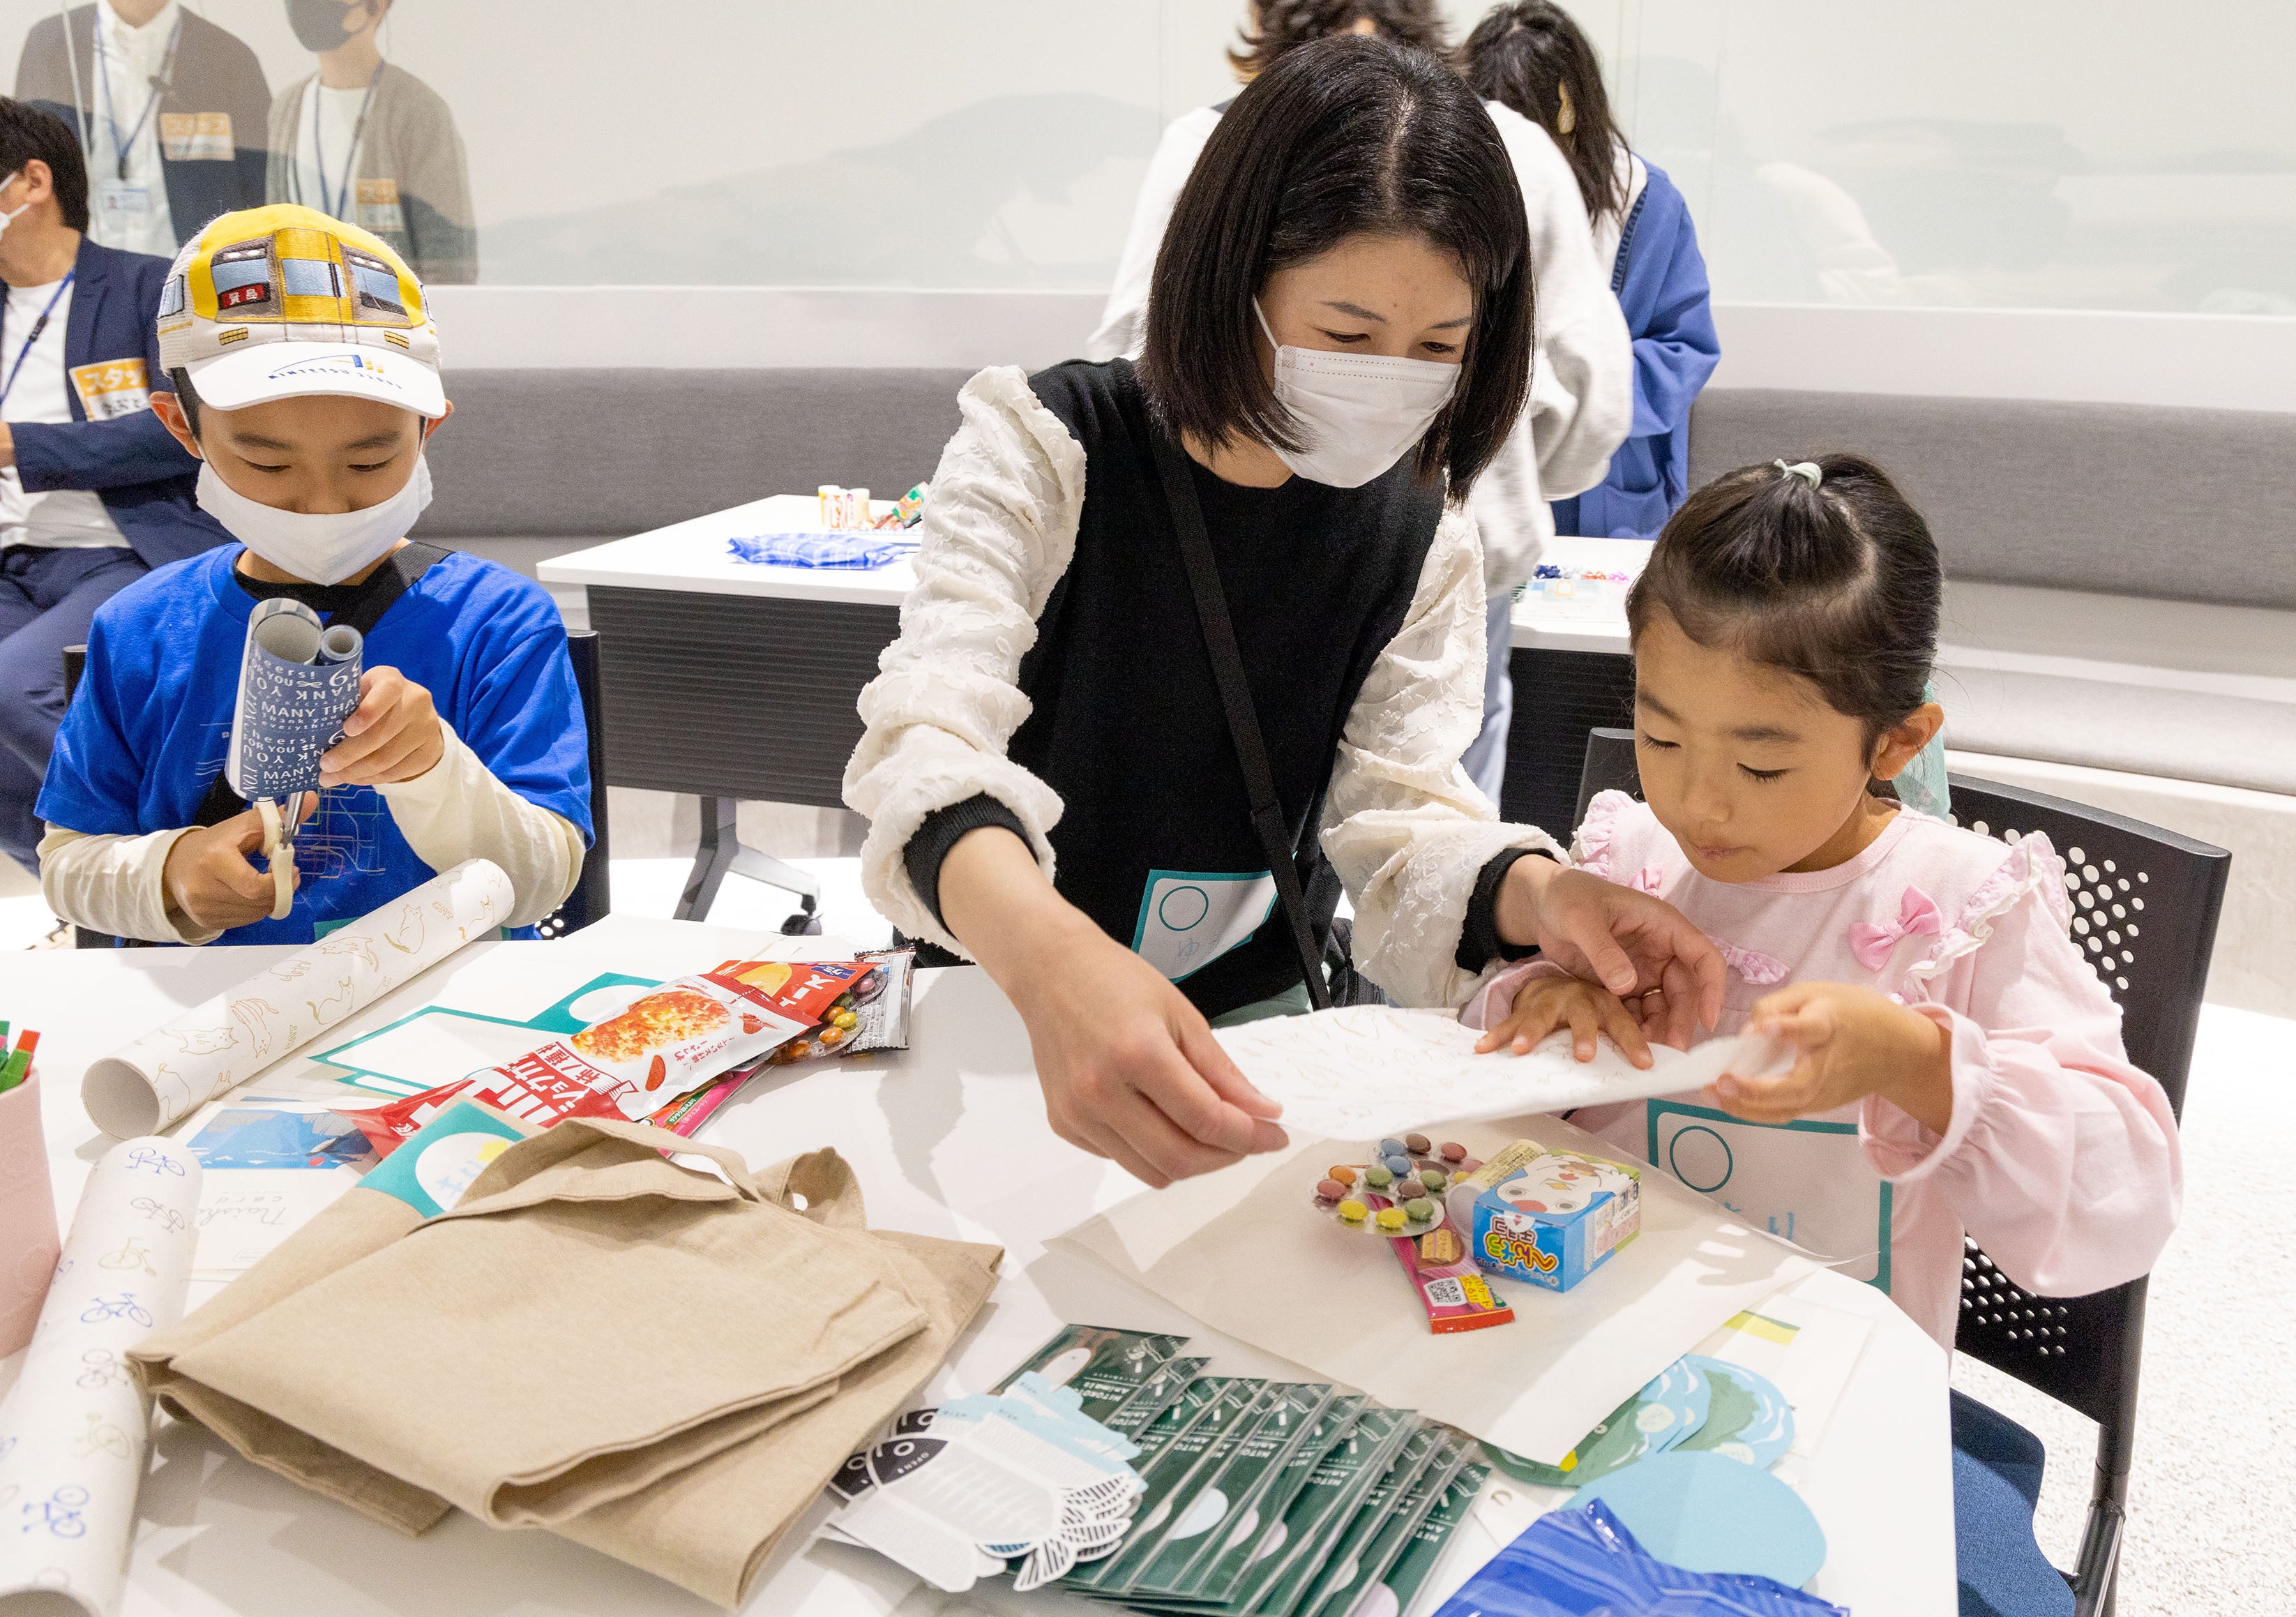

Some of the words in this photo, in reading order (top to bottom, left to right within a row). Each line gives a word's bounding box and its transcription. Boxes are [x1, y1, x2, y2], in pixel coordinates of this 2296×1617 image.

[254, 647, 315, 680] heers!
[262, 701, 316, 718] MANY
[252, 729, 316, 745] heers!
[268, 745, 295, 753] YOU
[264, 765, 316, 780] MANY
[432, 901, 454, 921] CAT
[1487, 1234, 1555, 1270] へんそう
